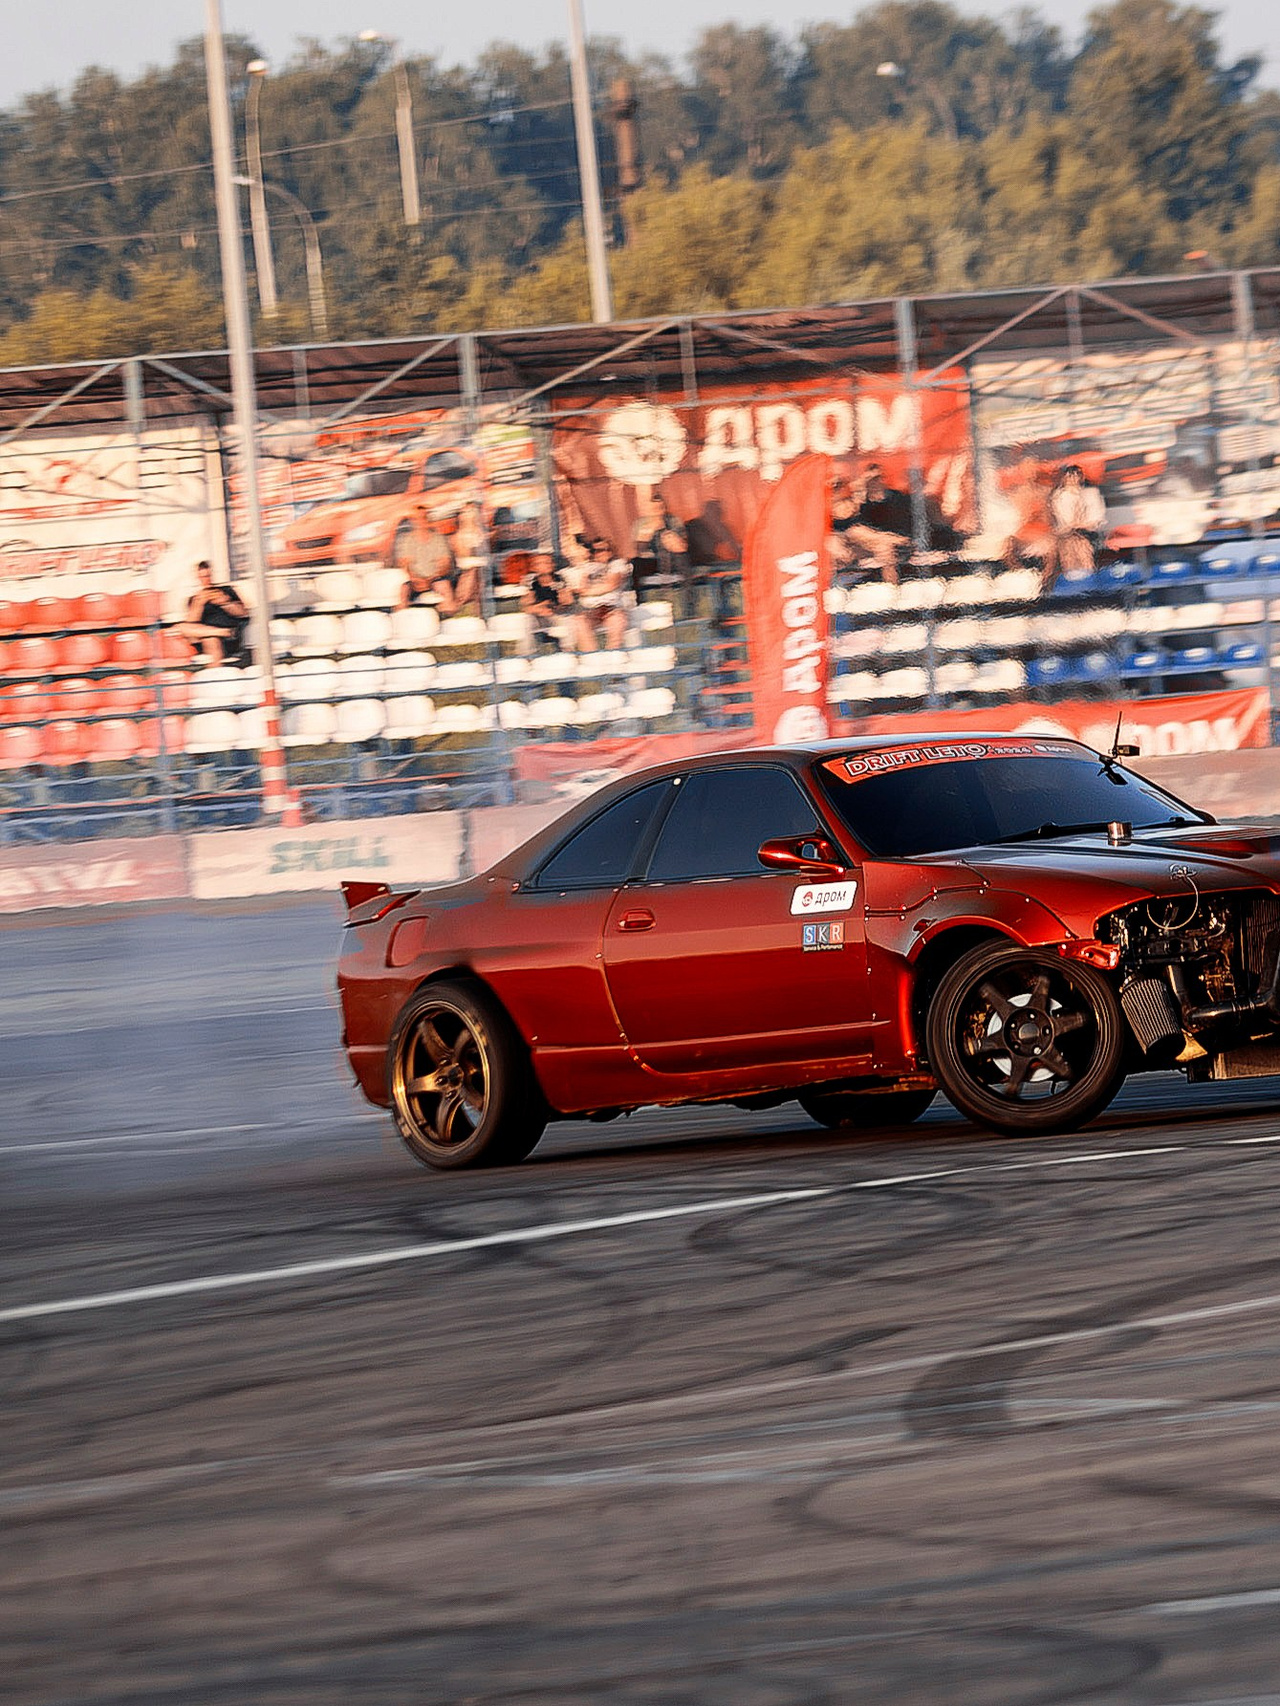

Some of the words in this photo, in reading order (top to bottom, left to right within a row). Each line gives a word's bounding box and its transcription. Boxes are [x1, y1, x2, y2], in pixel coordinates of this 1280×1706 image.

[846, 749, 920, 776] DRIFT
[926, 743, 987, 759] LETO
[804, 923, 842, 943] SKR
